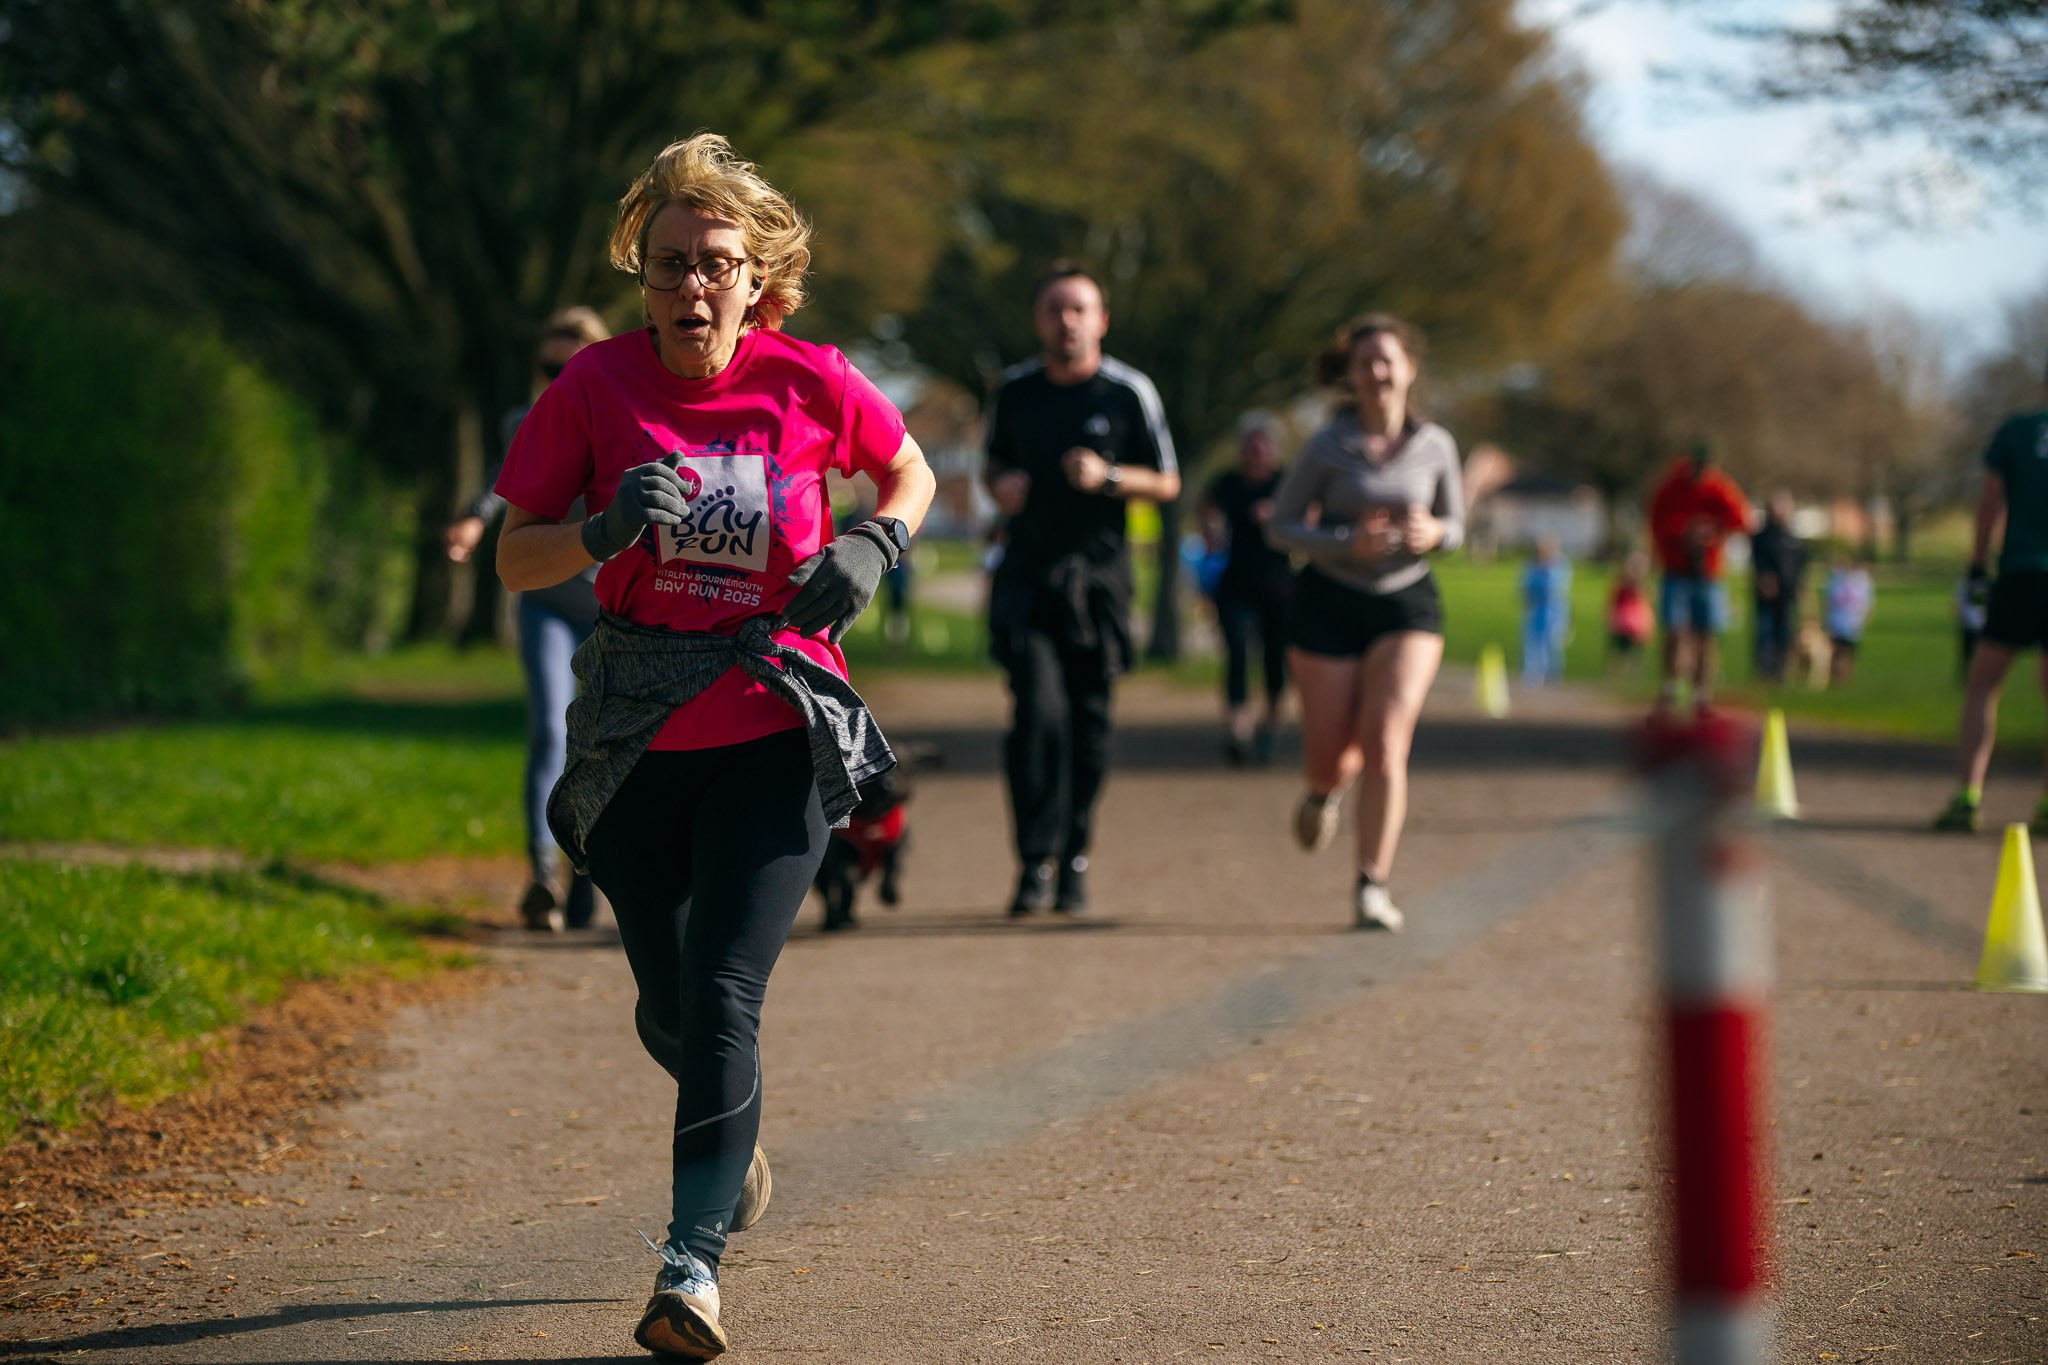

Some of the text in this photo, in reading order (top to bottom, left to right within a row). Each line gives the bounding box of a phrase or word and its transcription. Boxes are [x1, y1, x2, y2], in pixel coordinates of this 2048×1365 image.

[675, 533, 752, 556] RUN
[655, 578, 761, 607] BAY RUN 2025
[657, 569, 764, 593] VITALITY BOURNEMOUTH
